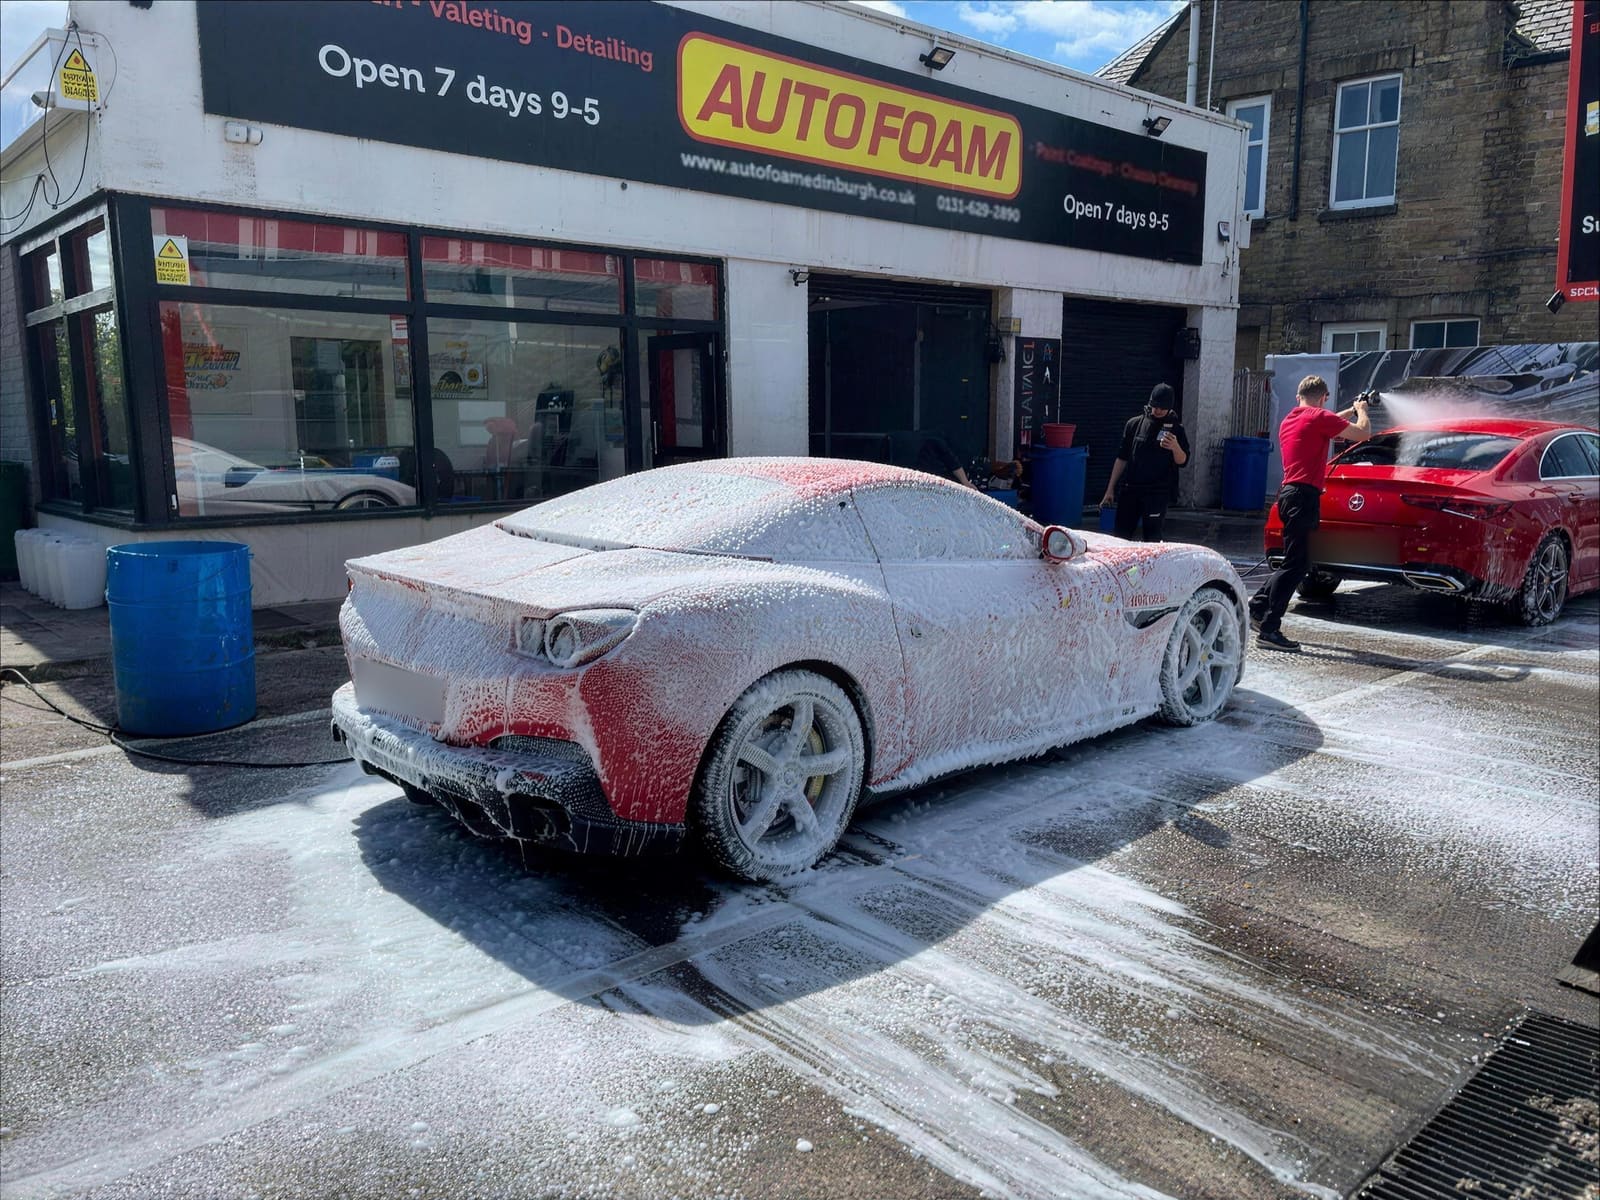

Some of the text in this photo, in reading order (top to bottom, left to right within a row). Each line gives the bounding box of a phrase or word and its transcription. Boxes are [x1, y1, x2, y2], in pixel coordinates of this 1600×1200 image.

[430, 0, 654, 73] Valeting Detailing
[318, 44, 601, 126] Open 7 days 9-5
[680, 152, 917, 206] www.autofoamedinburgh.co.uk
[1064, 194, 1169, 231] Open 7 days 9-5
